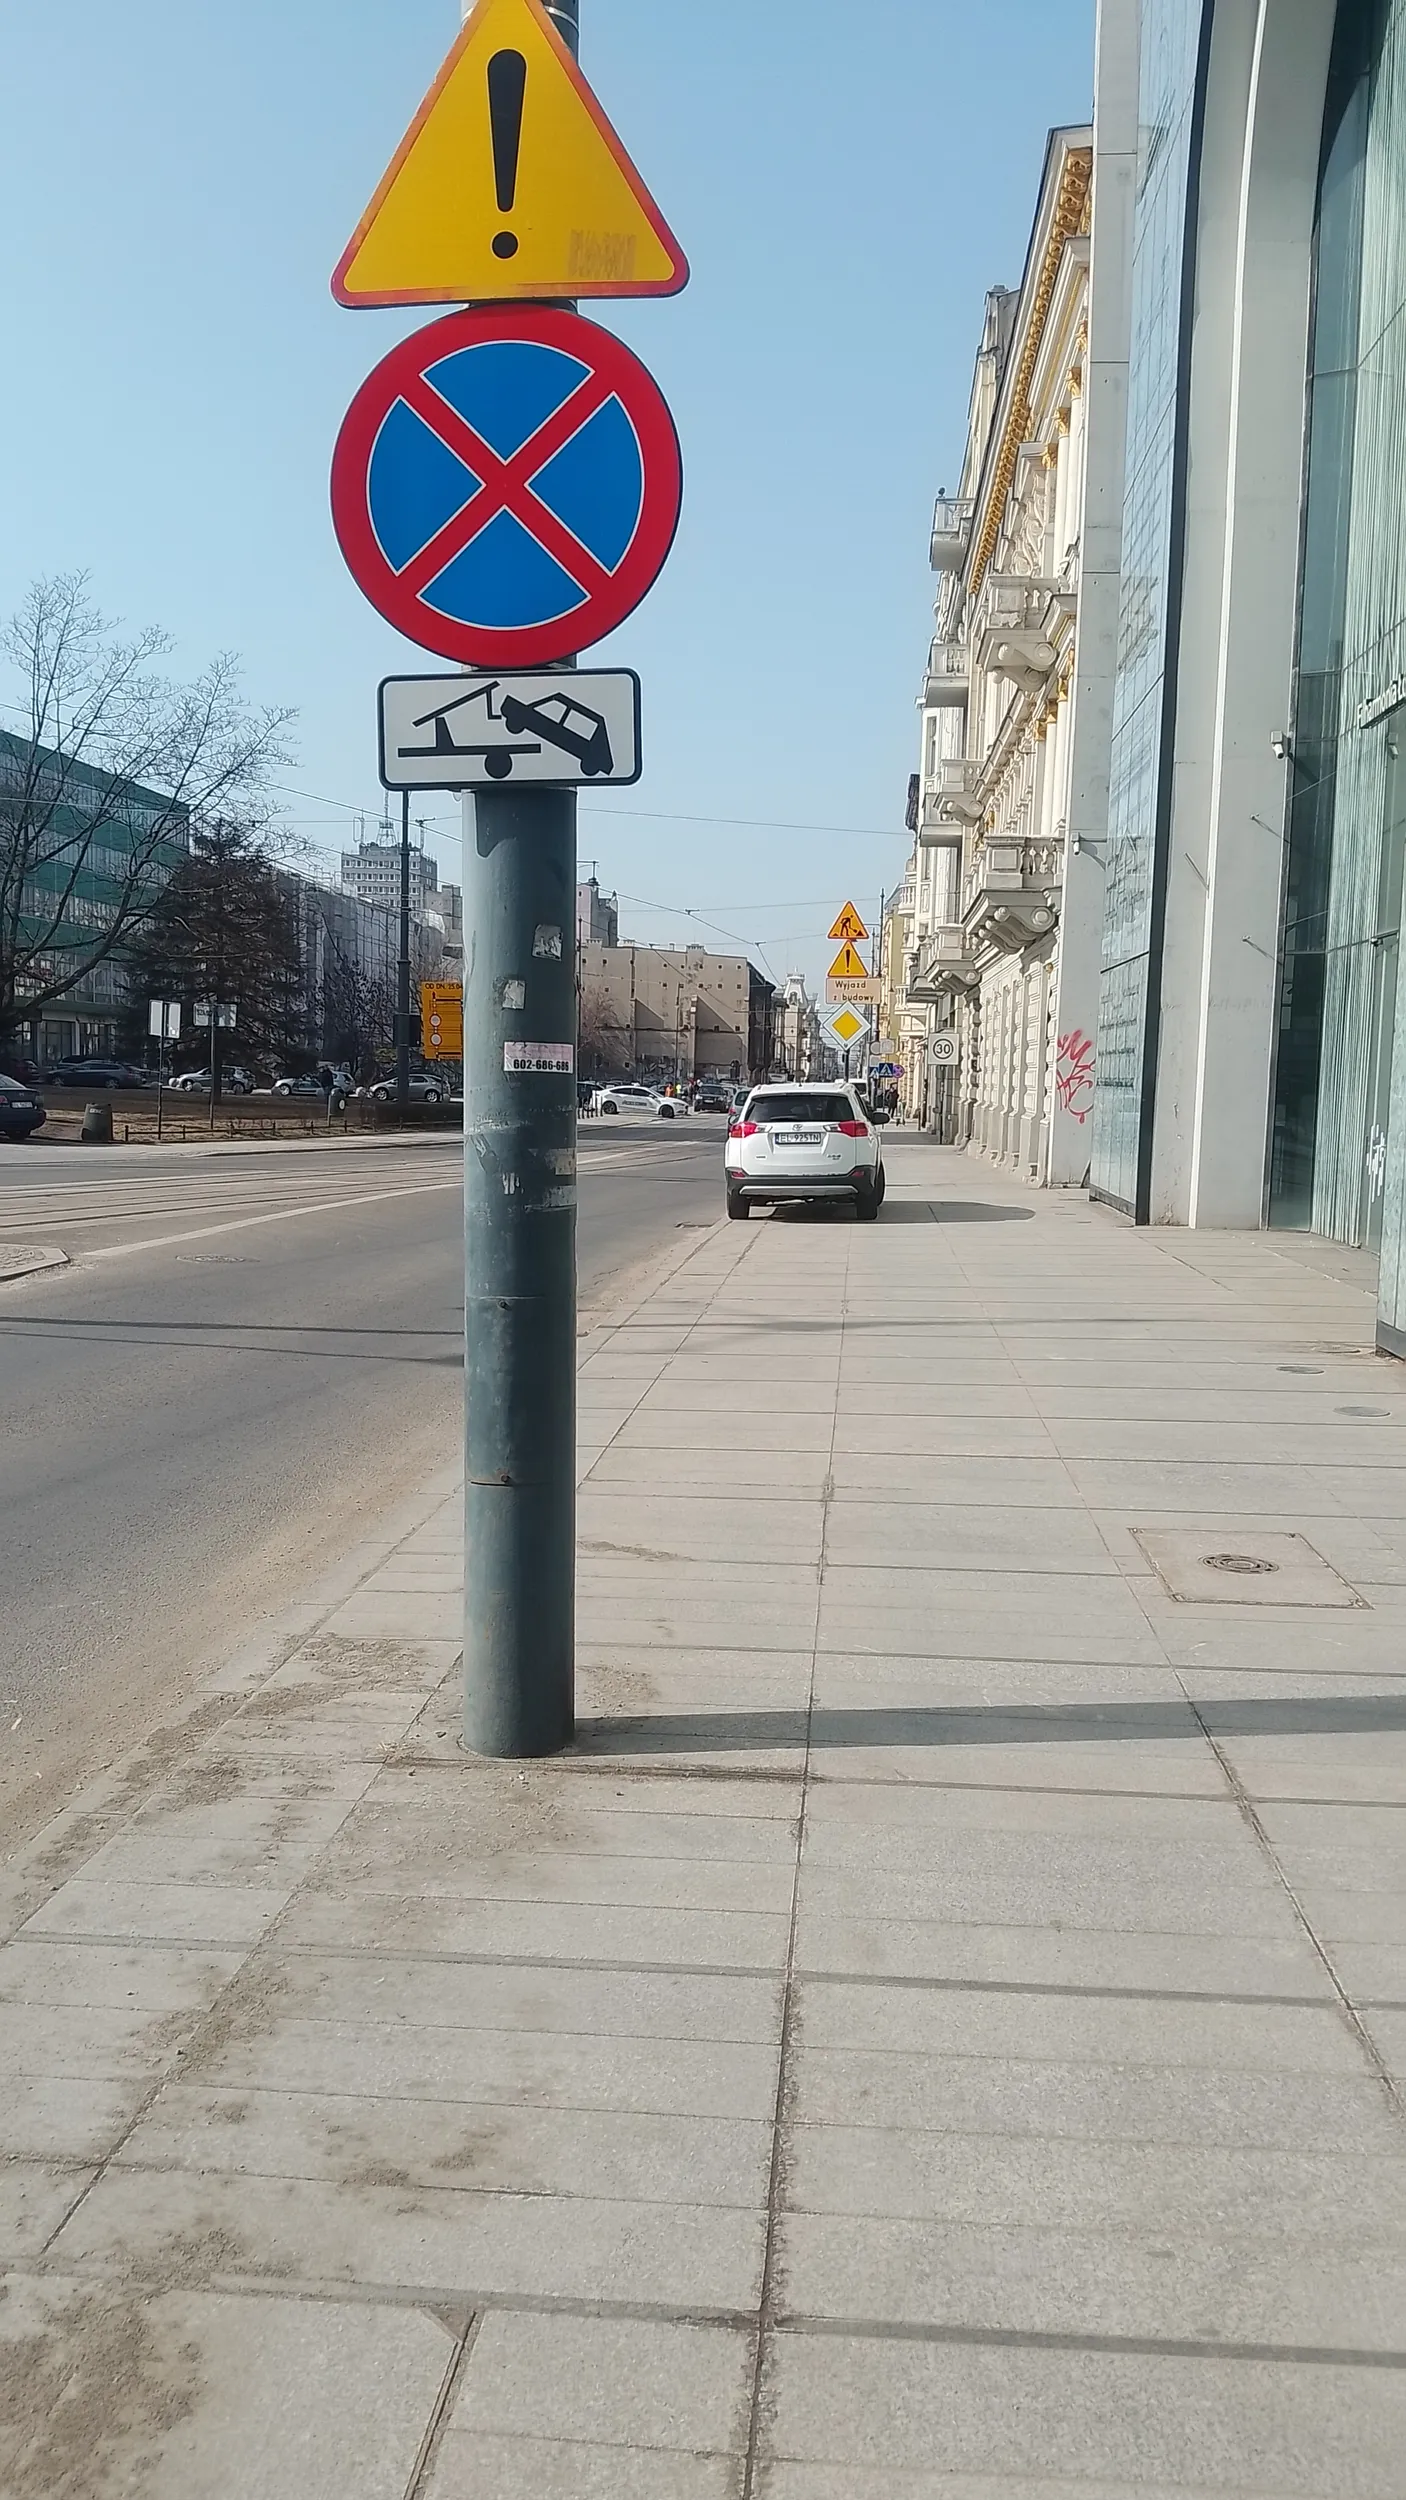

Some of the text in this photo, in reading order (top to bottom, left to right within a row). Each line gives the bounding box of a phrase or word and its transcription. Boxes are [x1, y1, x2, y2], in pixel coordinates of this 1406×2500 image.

[835, 980, 866, 990] Wyjazd
[842, 993, 874, 1003] budowy
[936, 1044, 951, 1054] 30
[780, 1134, 791, 1142] EL
